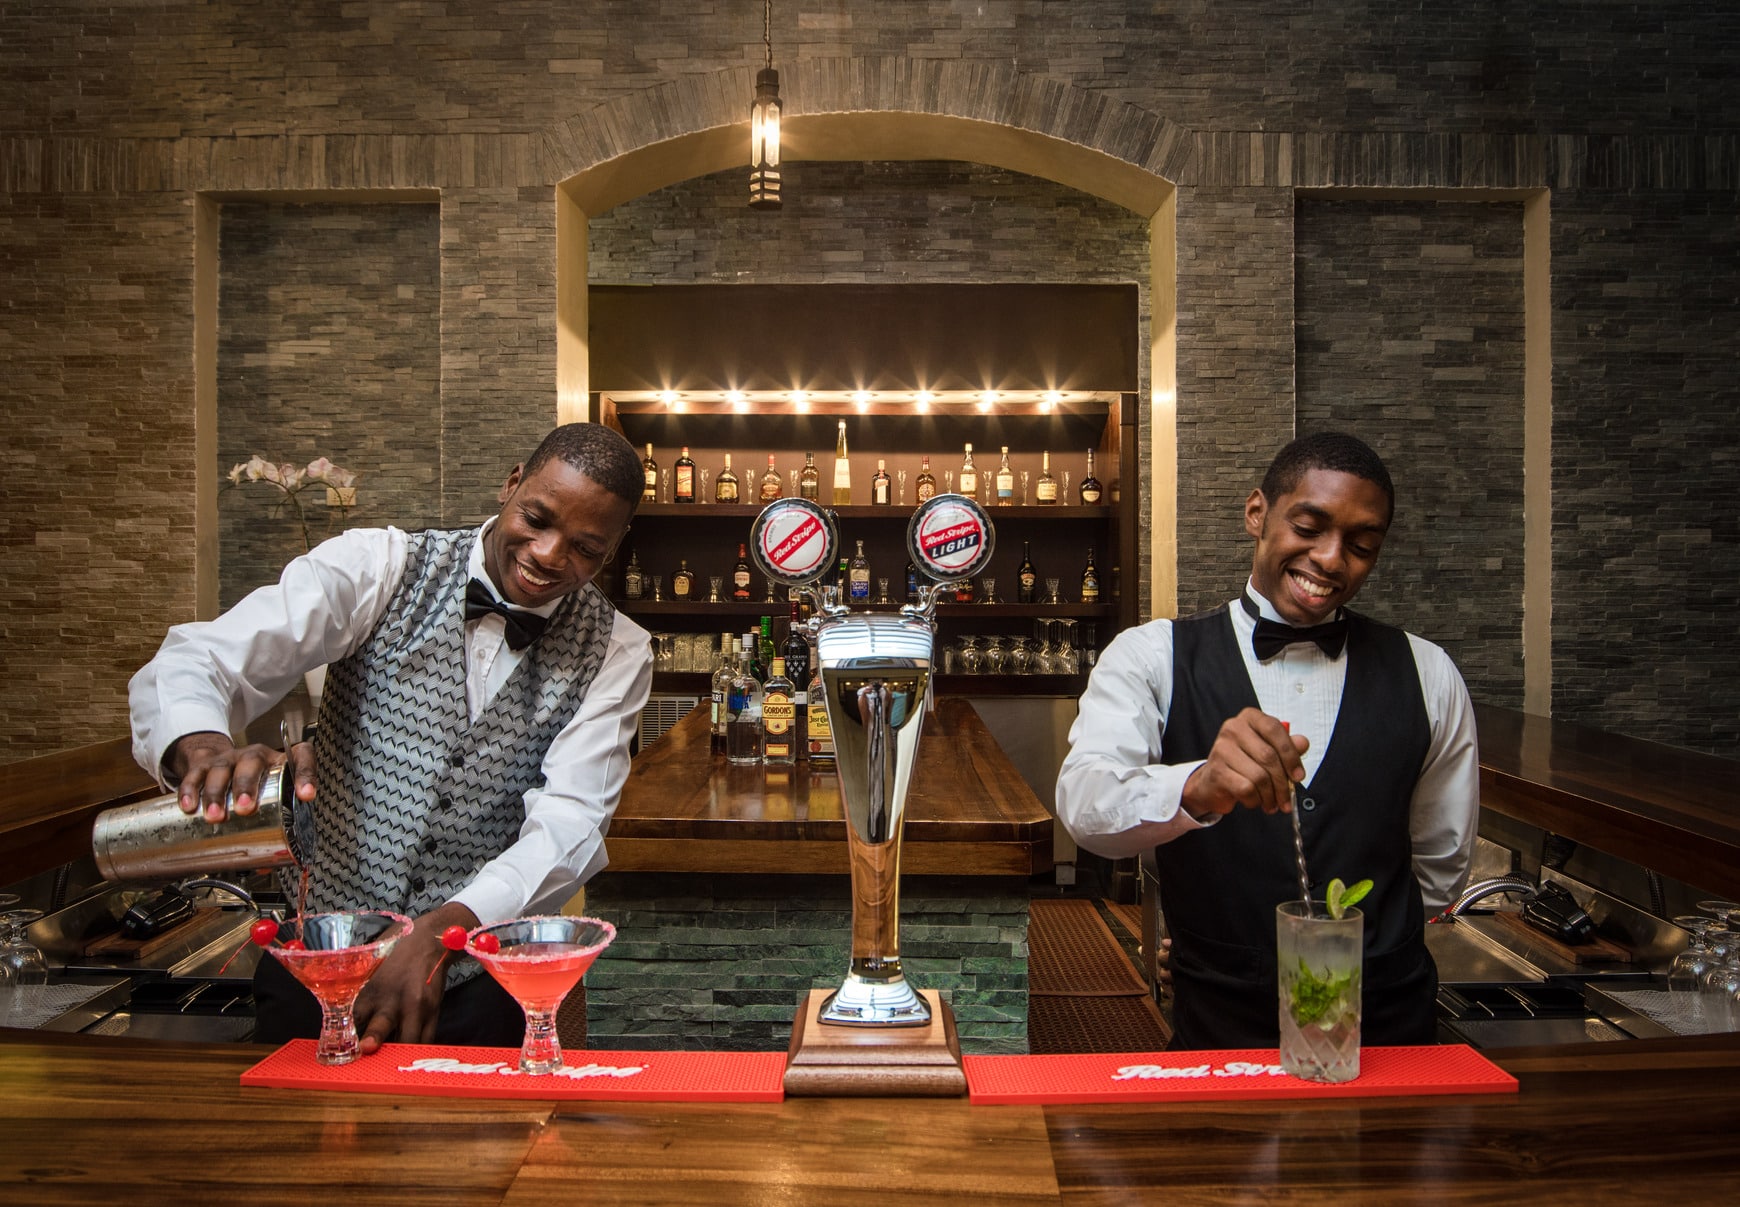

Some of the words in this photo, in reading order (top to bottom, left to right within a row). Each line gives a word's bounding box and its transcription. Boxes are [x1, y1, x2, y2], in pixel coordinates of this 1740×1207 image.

[773, 541, 792, 562] Red
[791, 521, 816, 547] Stripe
[925, 533, 946, 546] Red
[945, 524, 974, 540] Stripe
[932, 534, 976, 558] LIGHT
[1111, 1064, 1211, 1080] Red
